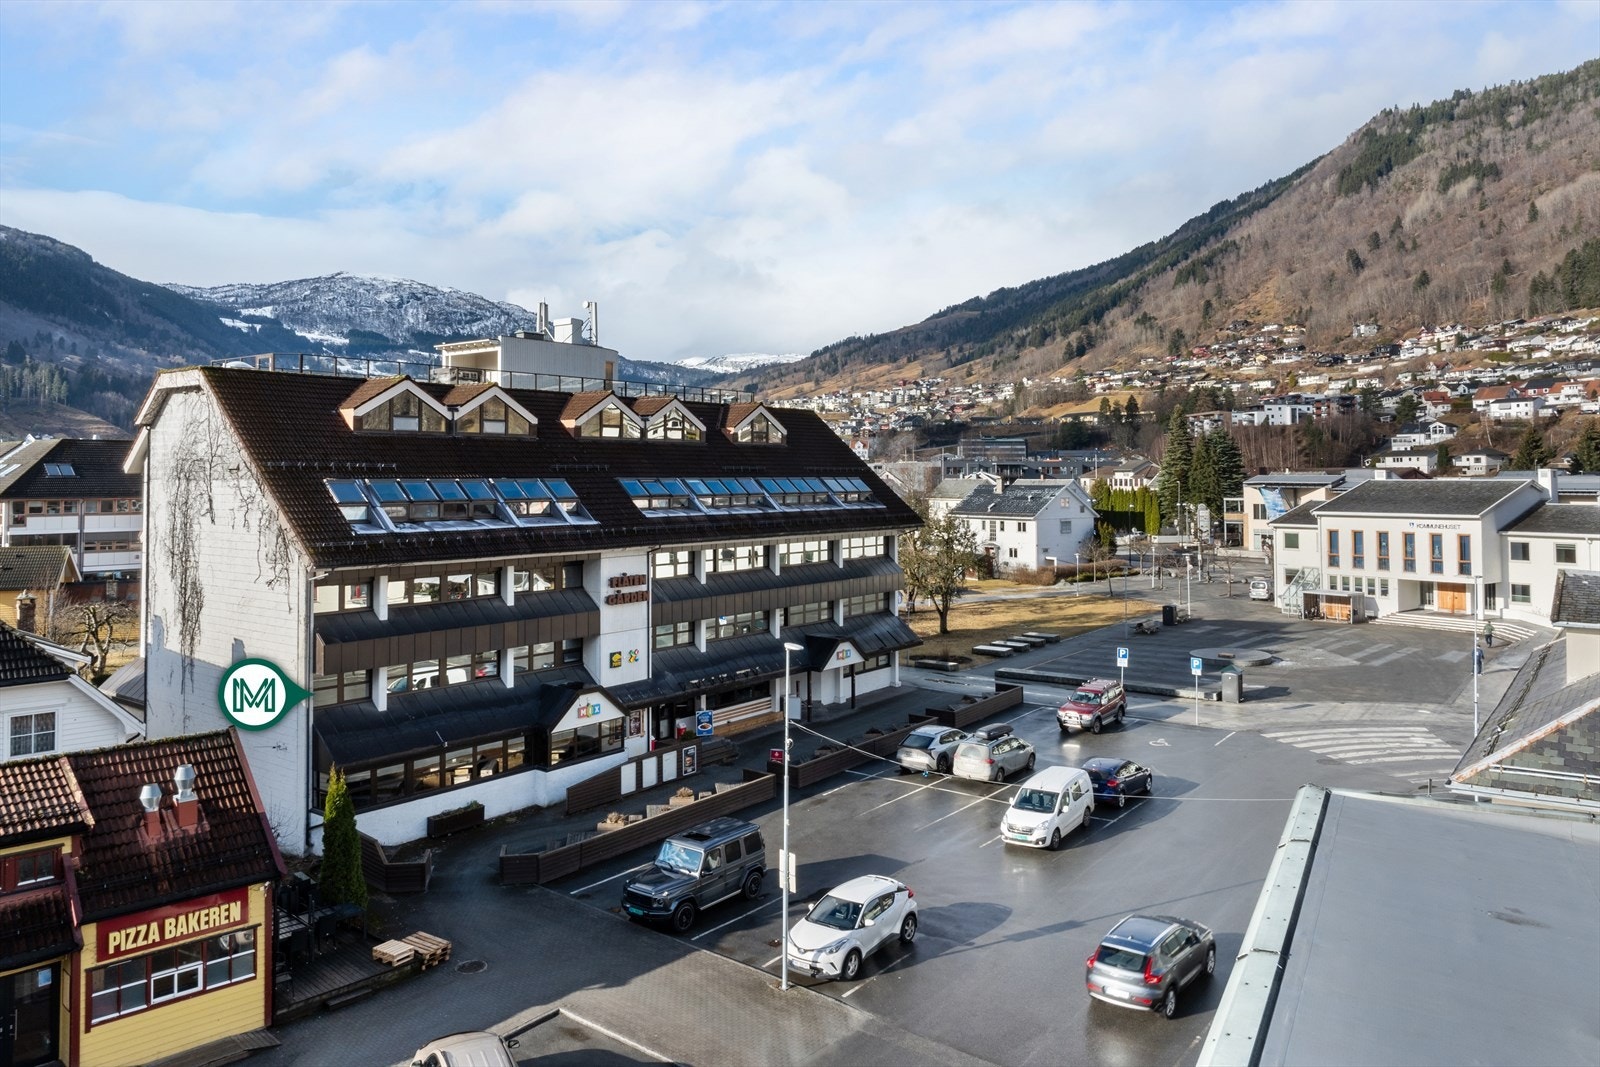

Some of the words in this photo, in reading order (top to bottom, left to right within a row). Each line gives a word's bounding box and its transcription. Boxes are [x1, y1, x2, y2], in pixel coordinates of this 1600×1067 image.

[1119, 649, 1126, 658] P
[1193, 660, 1200, 668] P
[578, 704, 600, 718] MIX
[108, 921, 160, 955] PIZZA
[164, 900, 241, 940] BAKEREN
